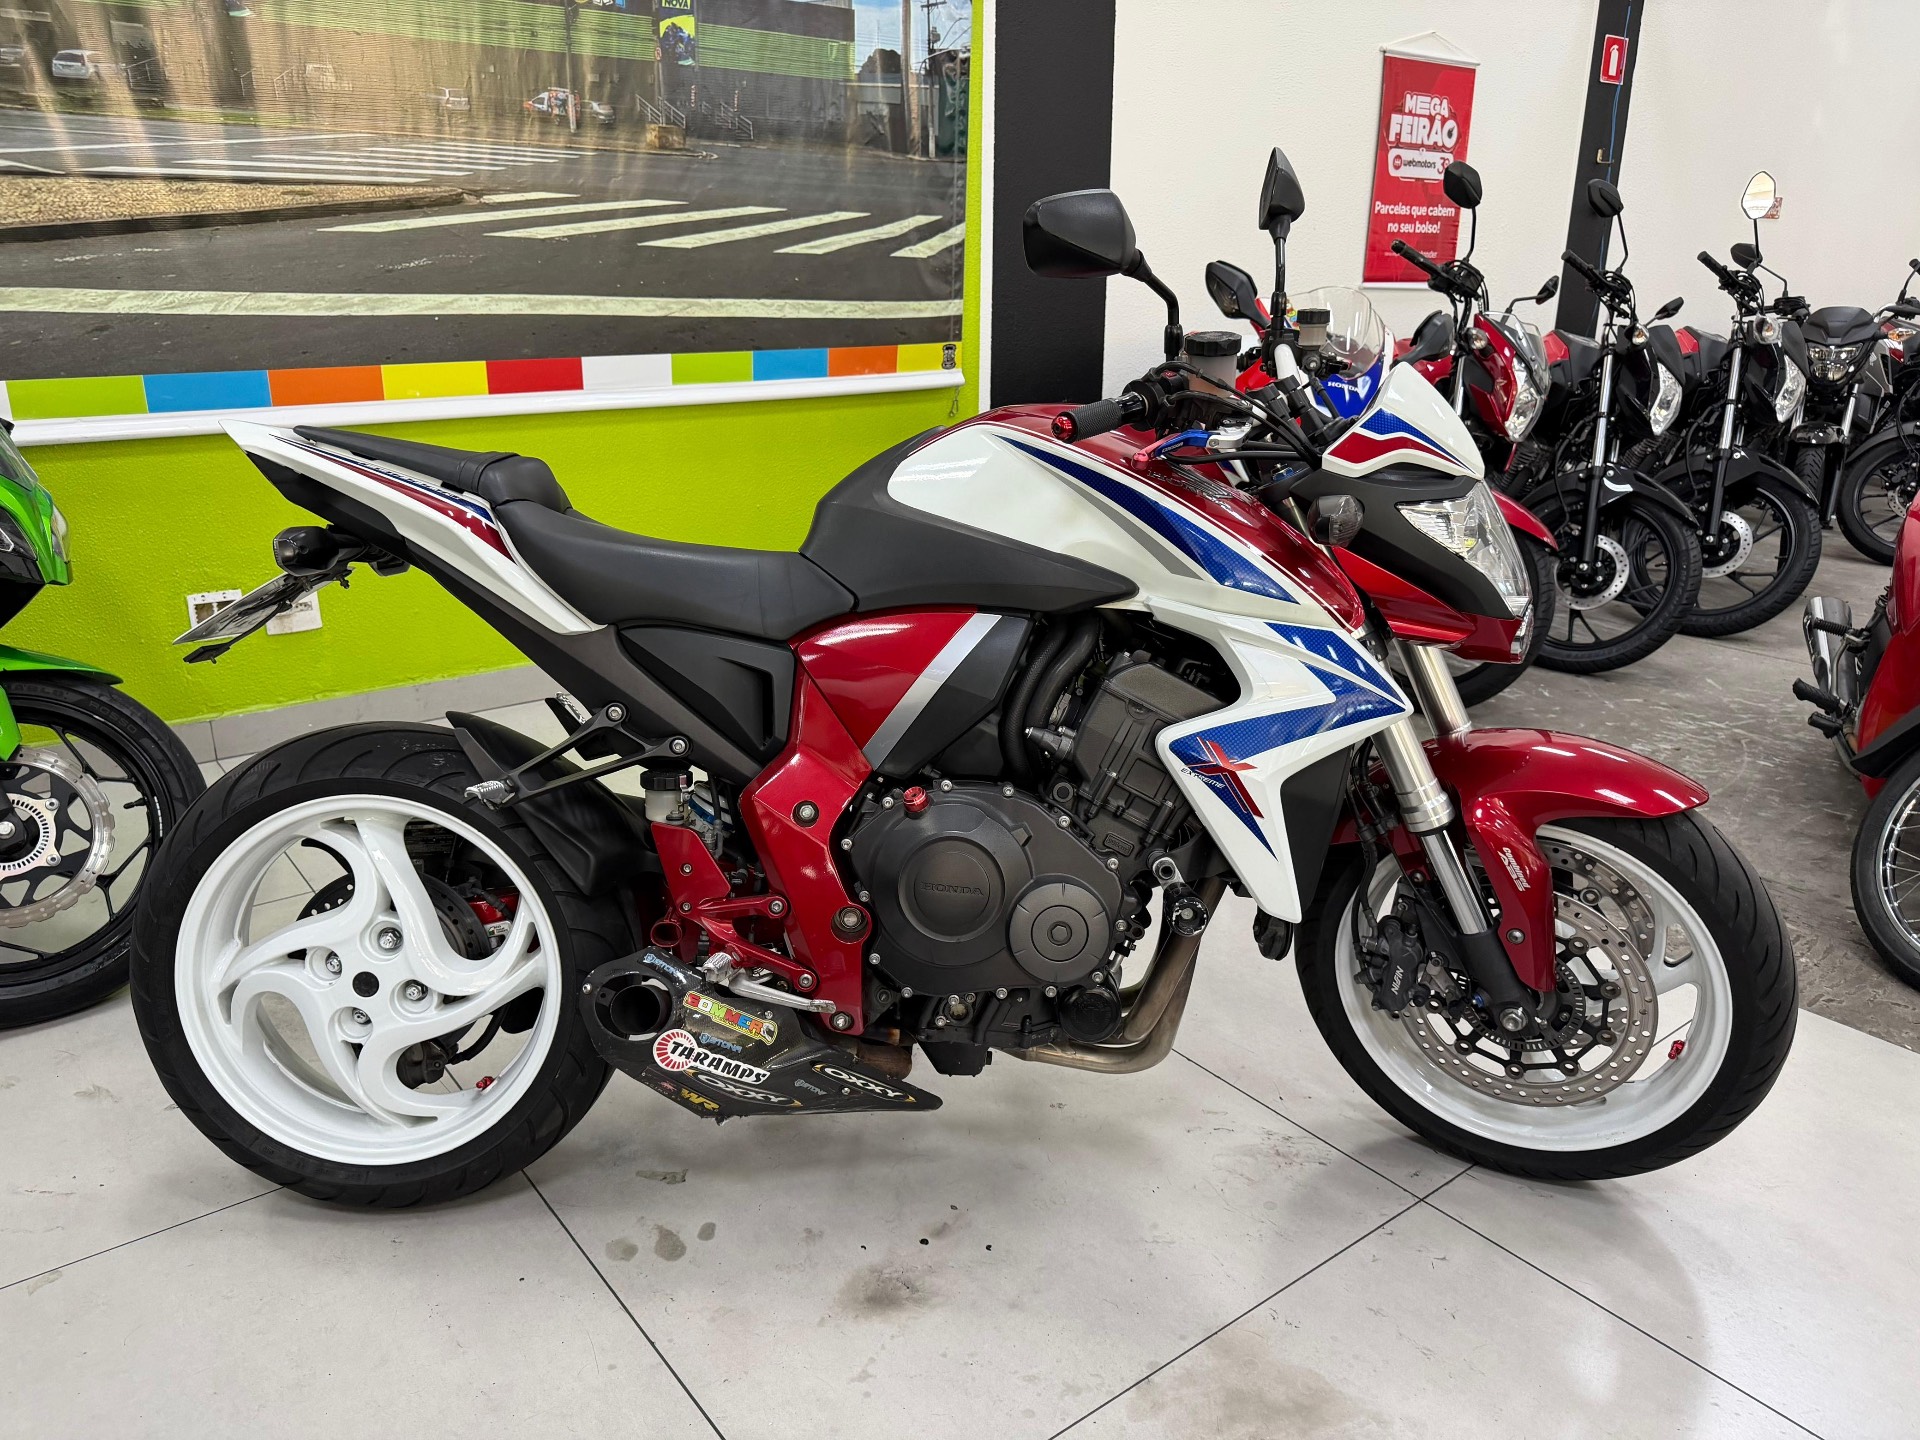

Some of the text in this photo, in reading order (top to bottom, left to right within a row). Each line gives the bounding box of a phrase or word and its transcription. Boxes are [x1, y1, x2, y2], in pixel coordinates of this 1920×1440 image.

[1404, 93, 1449, 118] MEGA
[1388, 113, 1458, 149] FEIRÃO
[1403, 157, 1437, 170] webmotors
[1374, 201, 1456, 219] Parcelas que cabem
[1387, 220, 1441, 234] no seu bolso!
[1327, 381, 1361, 393] HONDA
[88, 700, 138, 735] ROSSO
[1502, 846, 1531, 888] Combined
[920, 881, 985, 897] HONDA
[1391, 964, 1404, 995] NISSIN
[669, 1041, 767, 1083] TARAMPS
[697, 1074, 788, 1102] OXXY
[824, 1067, 904, 1098] OXXY
